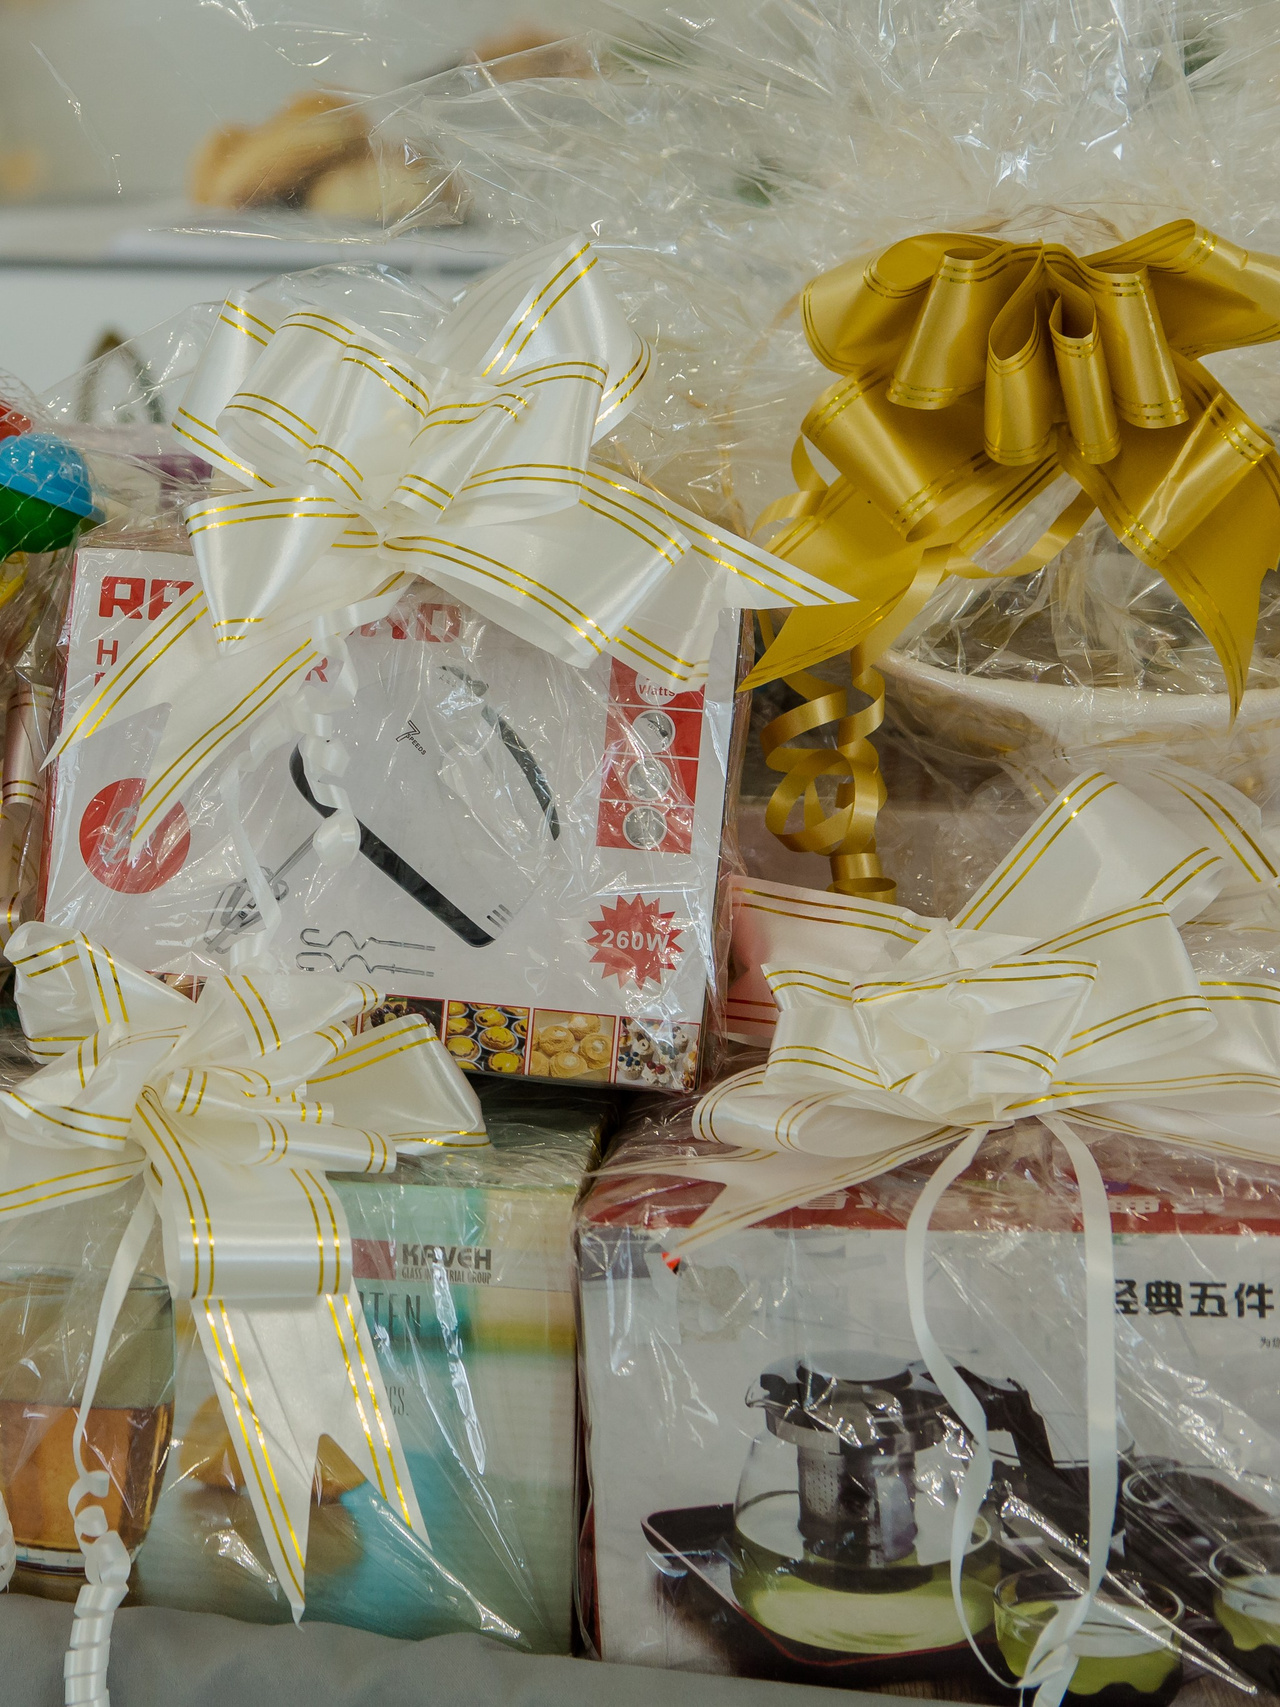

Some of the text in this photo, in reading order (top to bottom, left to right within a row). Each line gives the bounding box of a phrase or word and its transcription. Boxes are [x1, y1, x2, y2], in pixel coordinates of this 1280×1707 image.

[406, 733, 427, 756] SPEEDS
[600, 928, 670, 953] 260W
[401, 1243, 492, 1271] KAVEH
[401, 1266, 423, 1280] GLASS
[467, 1271, 492, 1285] GROUP
